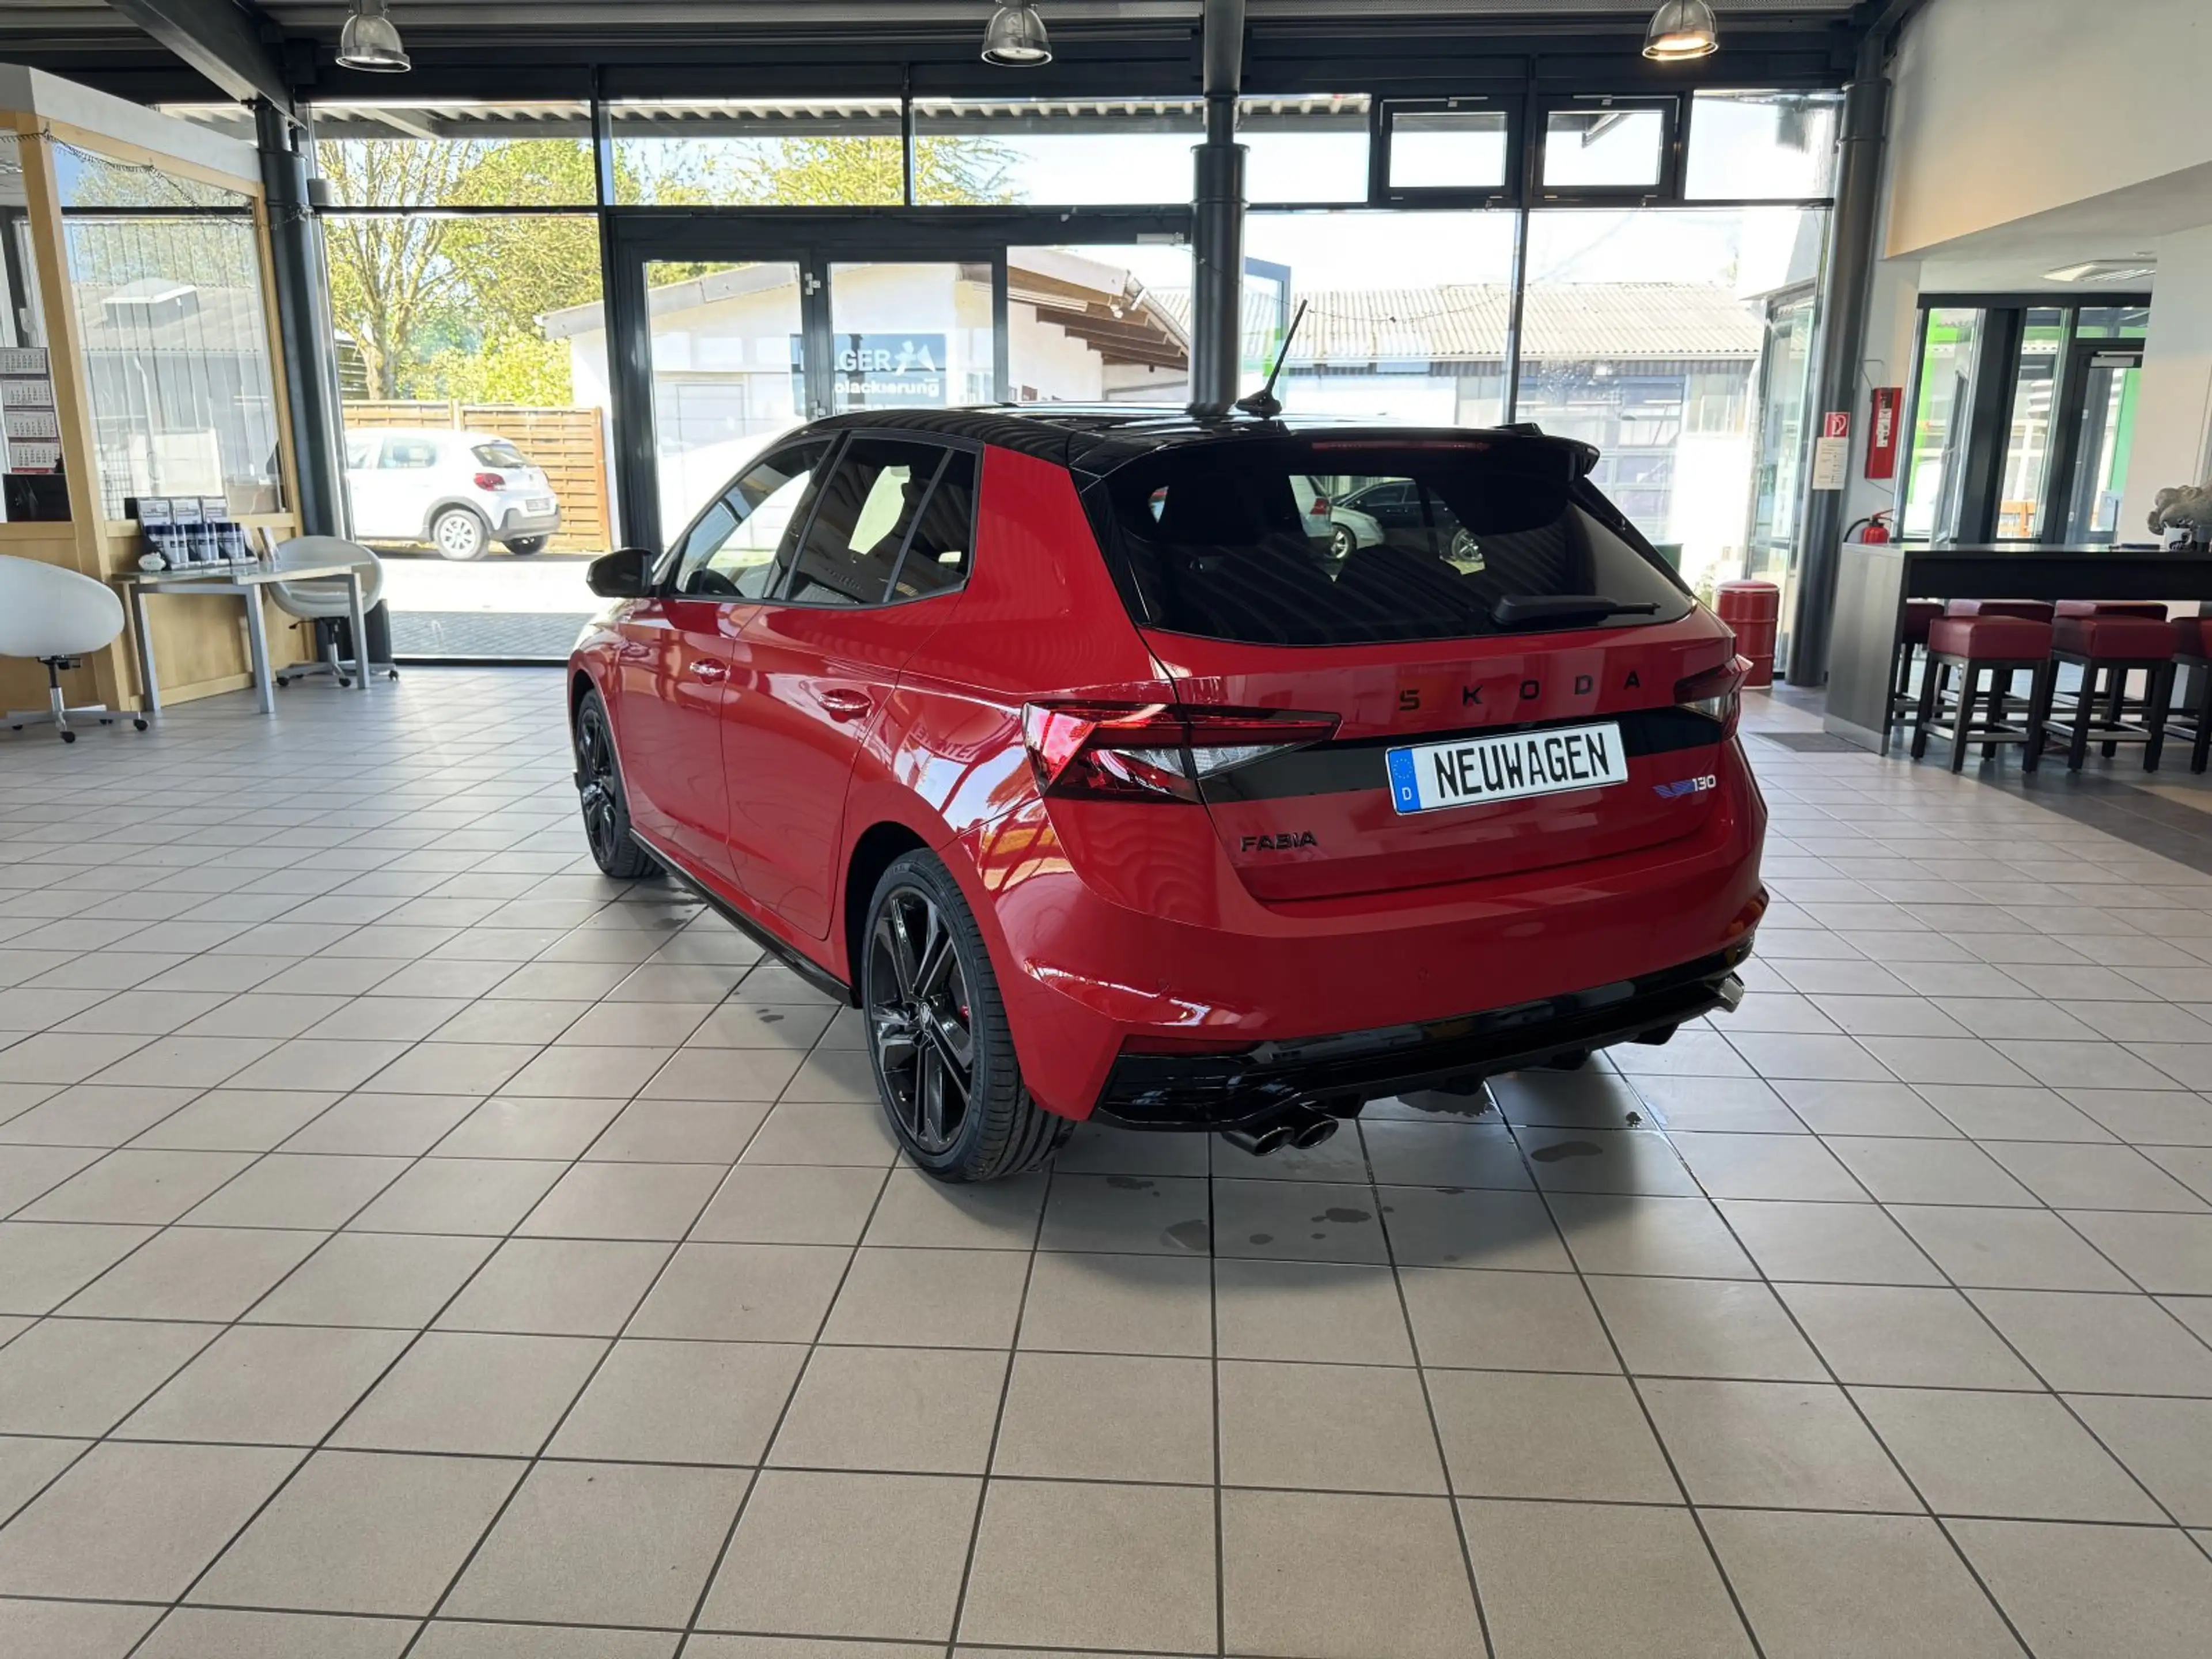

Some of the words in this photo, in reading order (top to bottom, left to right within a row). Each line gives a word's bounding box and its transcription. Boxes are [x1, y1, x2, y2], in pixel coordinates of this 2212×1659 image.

[1399, 671, 1641, 710] SKODA
[1433, 732, 1610, 798] NEUWAGEN
[1692, 774, 1716, 791] 130
[1402, 787, 1412, 800] D
[1240, 831, 1318, 852] FABIA
